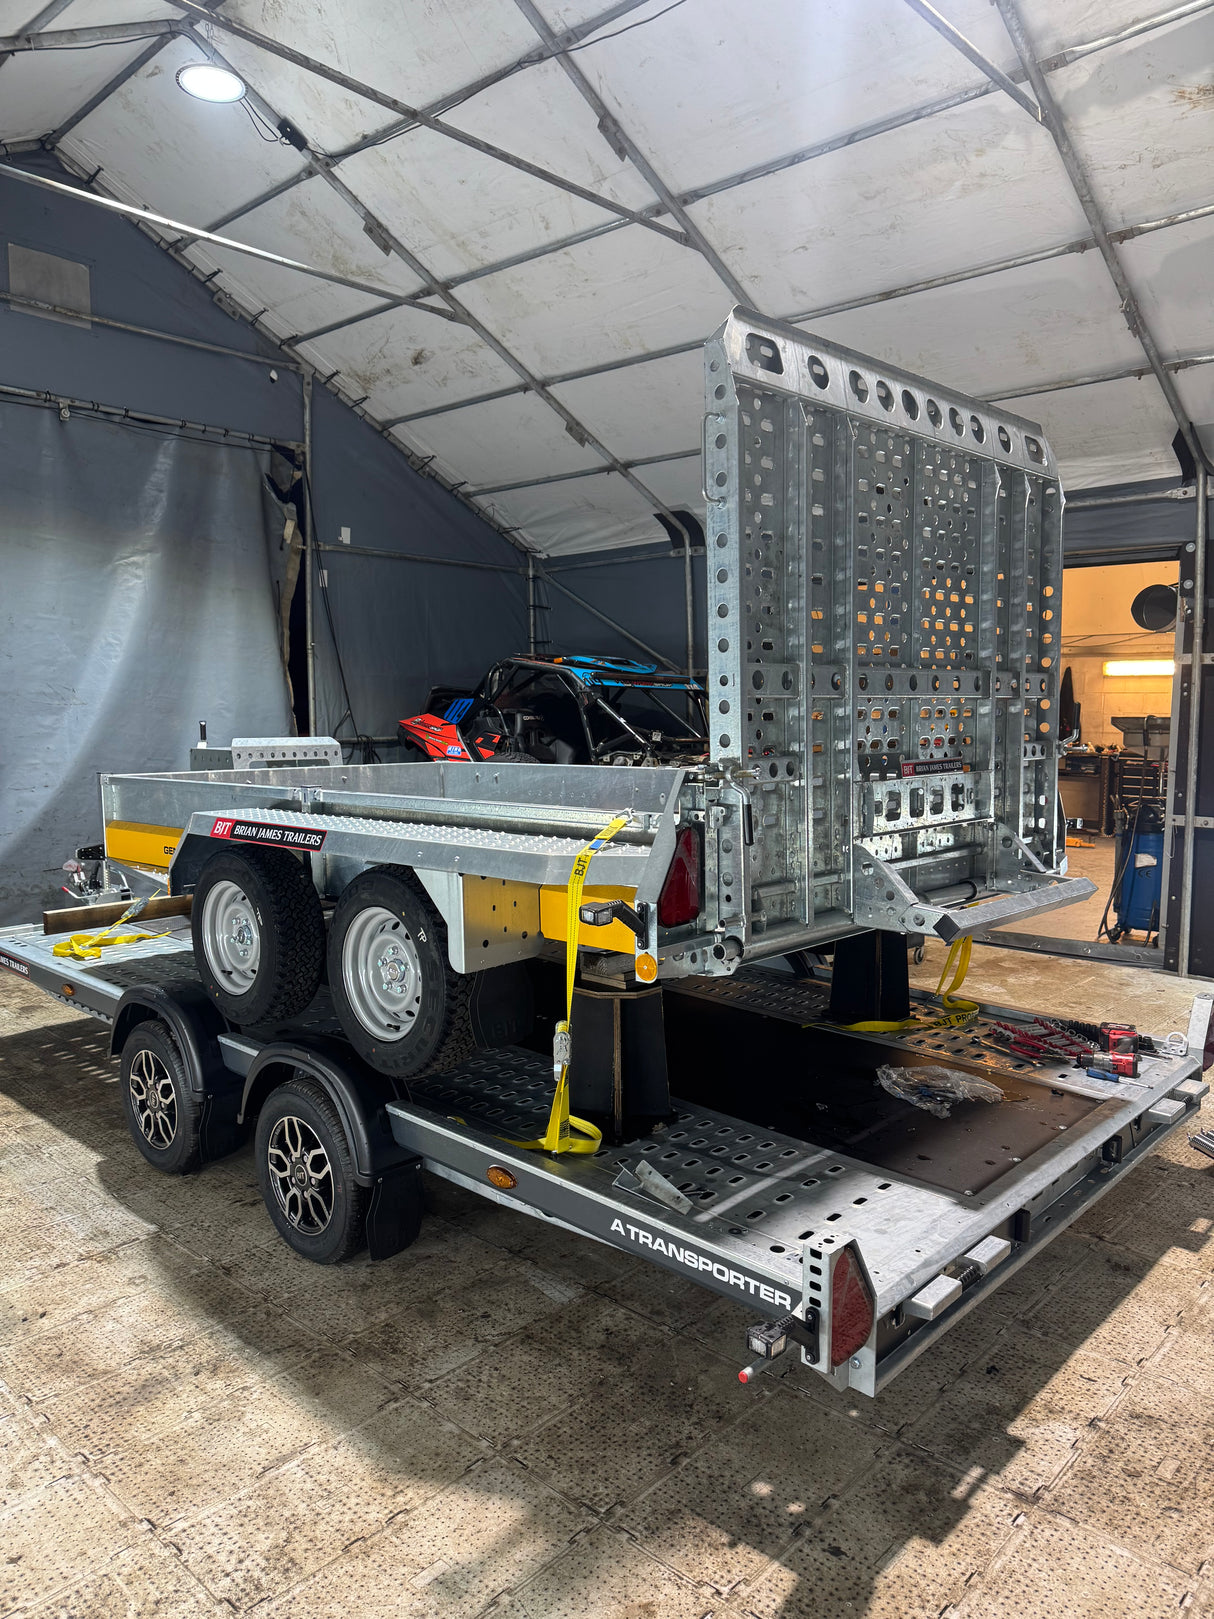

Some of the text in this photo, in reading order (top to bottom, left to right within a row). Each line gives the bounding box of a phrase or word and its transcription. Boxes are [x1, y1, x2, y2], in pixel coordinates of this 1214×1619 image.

[915, 764, 930, 773] BRIAN
[930, 763, 943, 772] JAMES
[943, 761, 962, 770] TRAILERS
[213, 821, 323, 846] BJT BRIAN JAMES TRAILERS
[574, 857, 588, 877] BJT
[9, 960, 29, 975] TRAILERS
[610, 1218, 792, 1311] A TRANSPORTER
